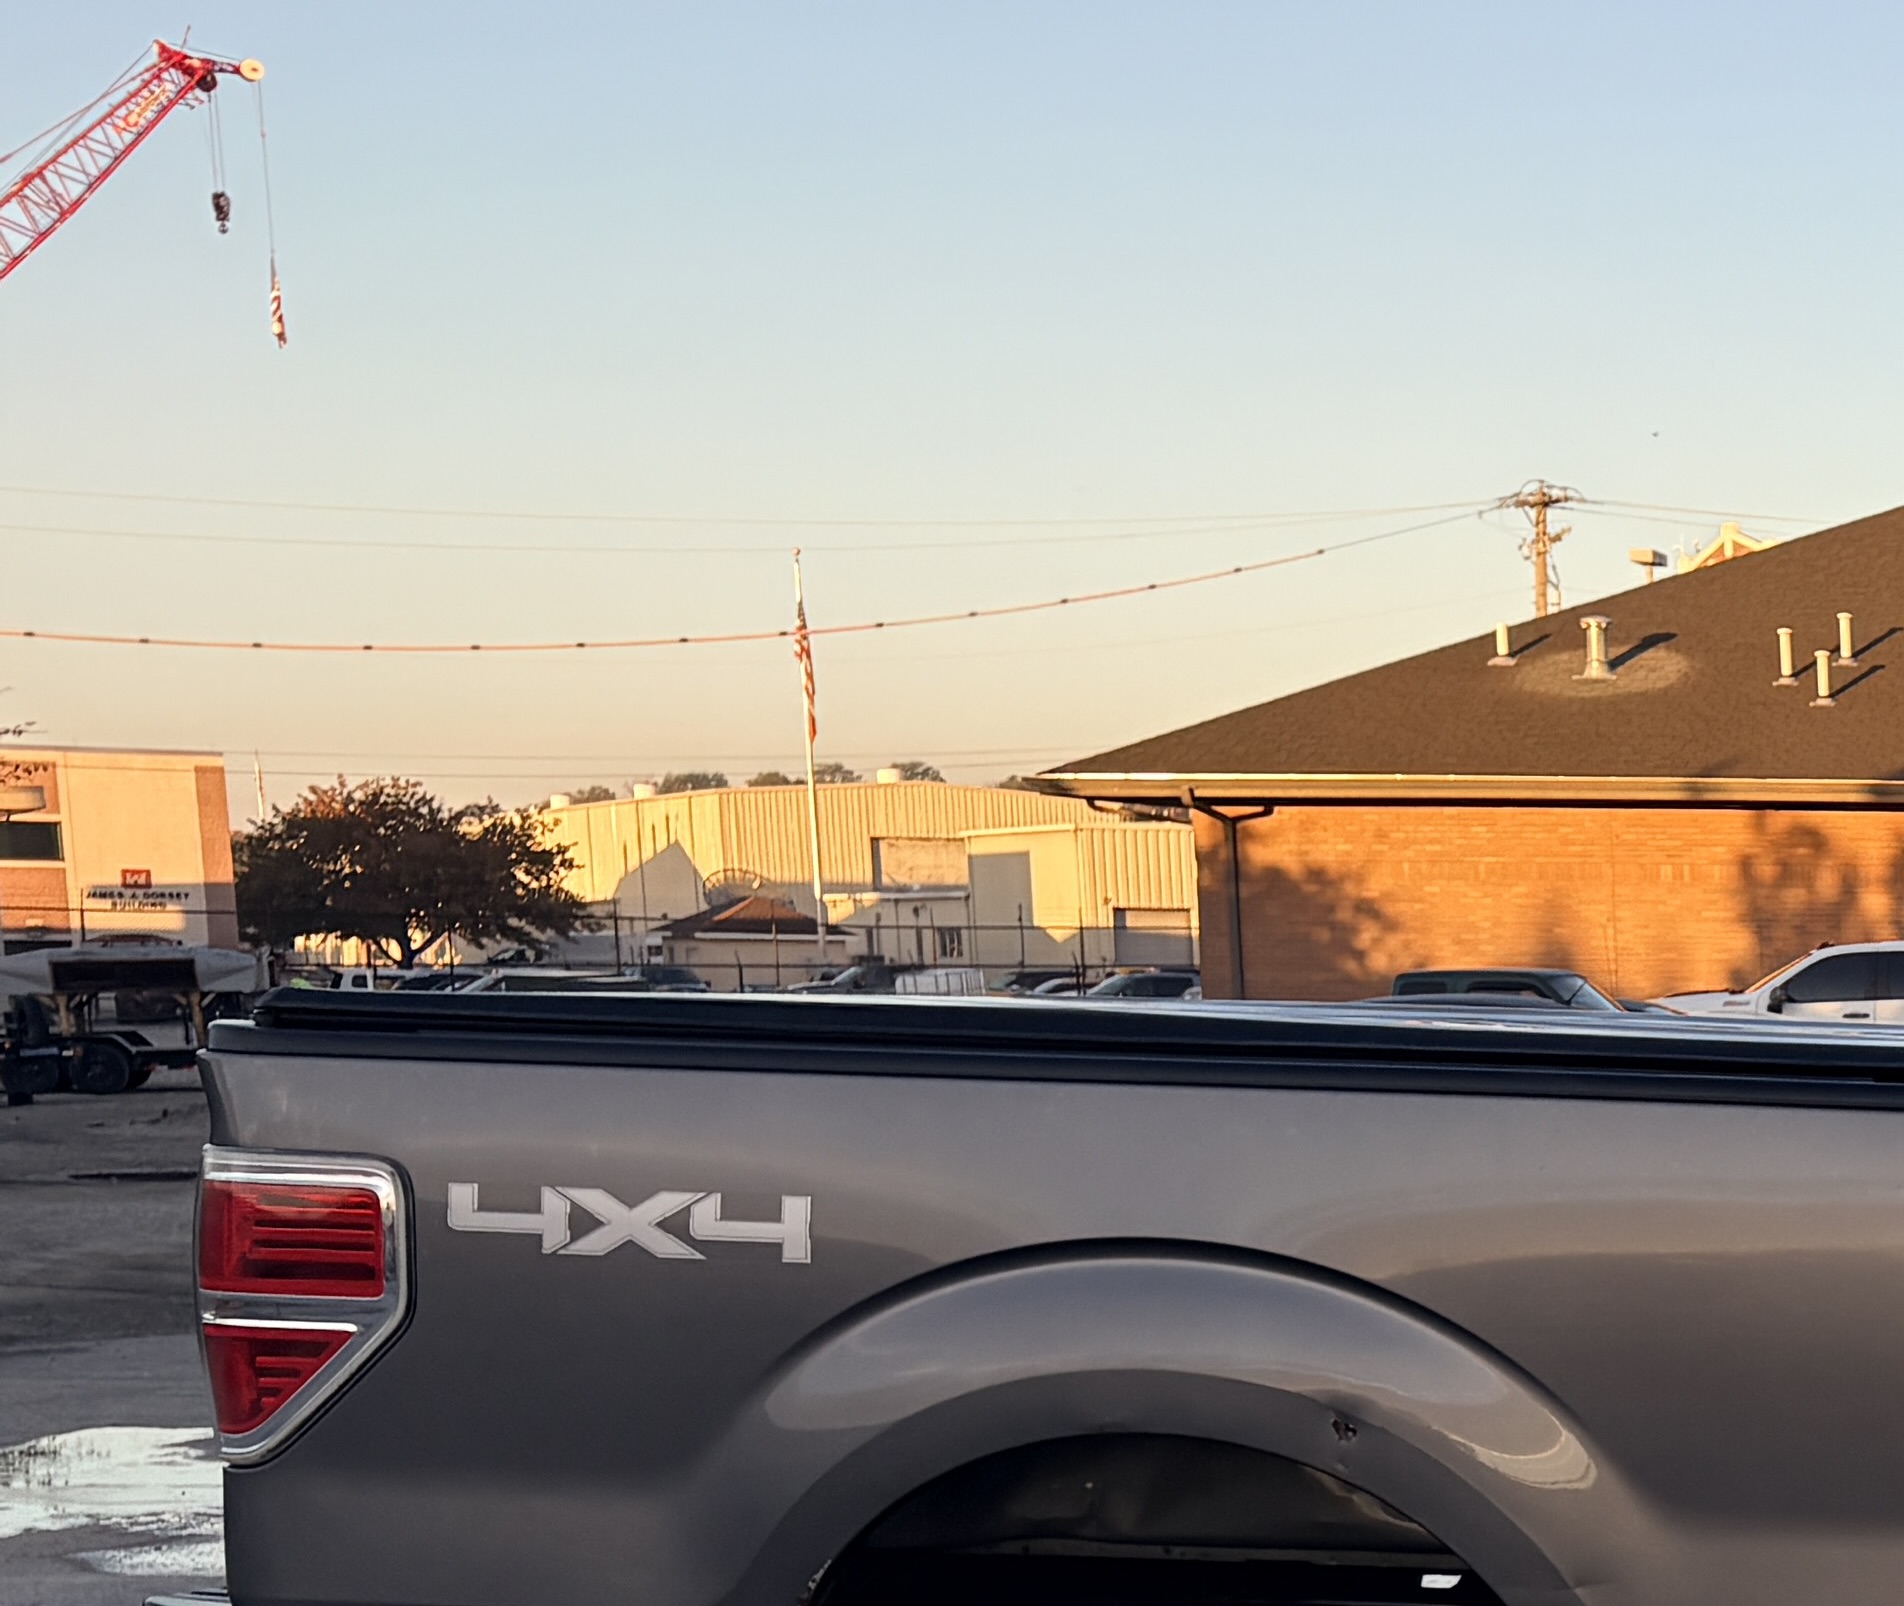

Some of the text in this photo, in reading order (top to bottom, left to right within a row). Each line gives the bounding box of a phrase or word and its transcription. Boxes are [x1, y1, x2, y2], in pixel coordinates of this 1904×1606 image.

[86, 891, 124, 899] JAMES
[142, 891, 190, 900] DORSEY
[447, 1182, 812, 1264] 4X4
